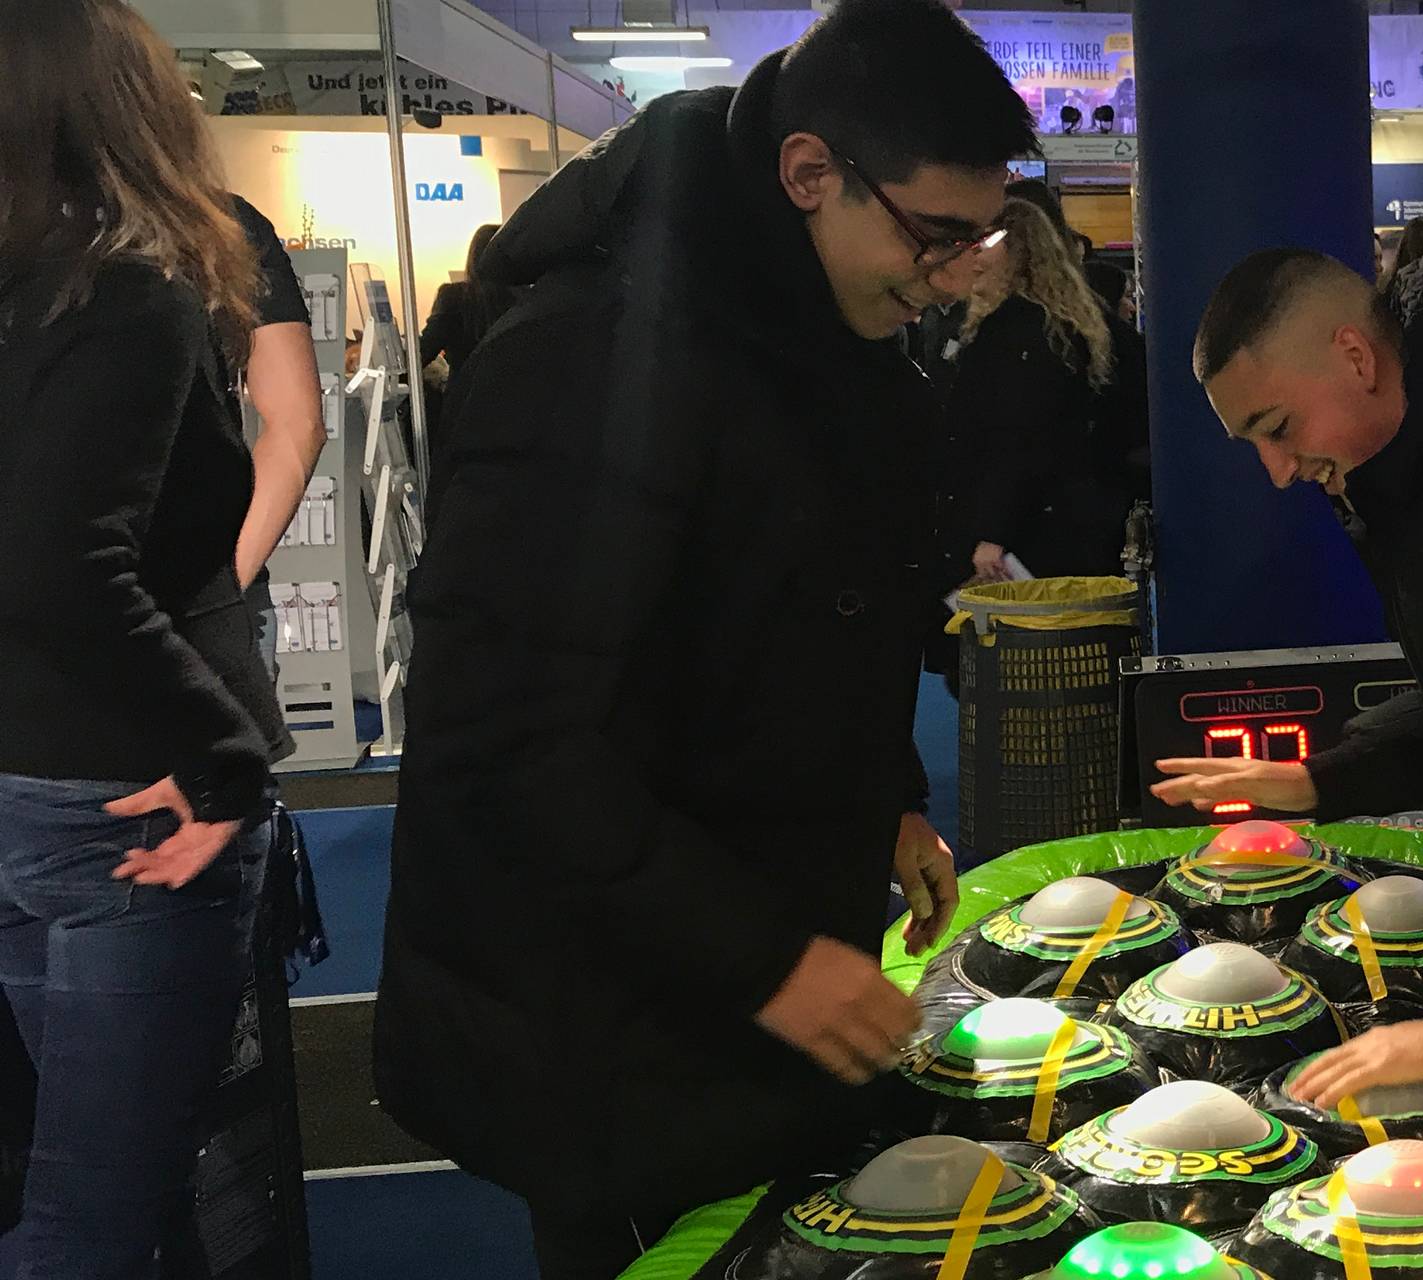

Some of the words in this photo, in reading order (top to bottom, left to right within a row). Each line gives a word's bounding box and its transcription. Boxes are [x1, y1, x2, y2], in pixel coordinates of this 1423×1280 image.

[985, 40, 1019, 60] ERDE
[1026, 41, 1055, 60] TEIL
[1061, 42, 1102, 61] EINER
[1000, 60, 1046, 80] OSSEN
[1053, 62, 1111, 81] FAMILIE
[308, 74, 351, 91] Und
[414, 74, 449, 91] ein
[415, 182, 464, 201] DAA
[1216, 693, 1288, 713] WINNER
[1183, 1003, 1261, 1031] HIT
